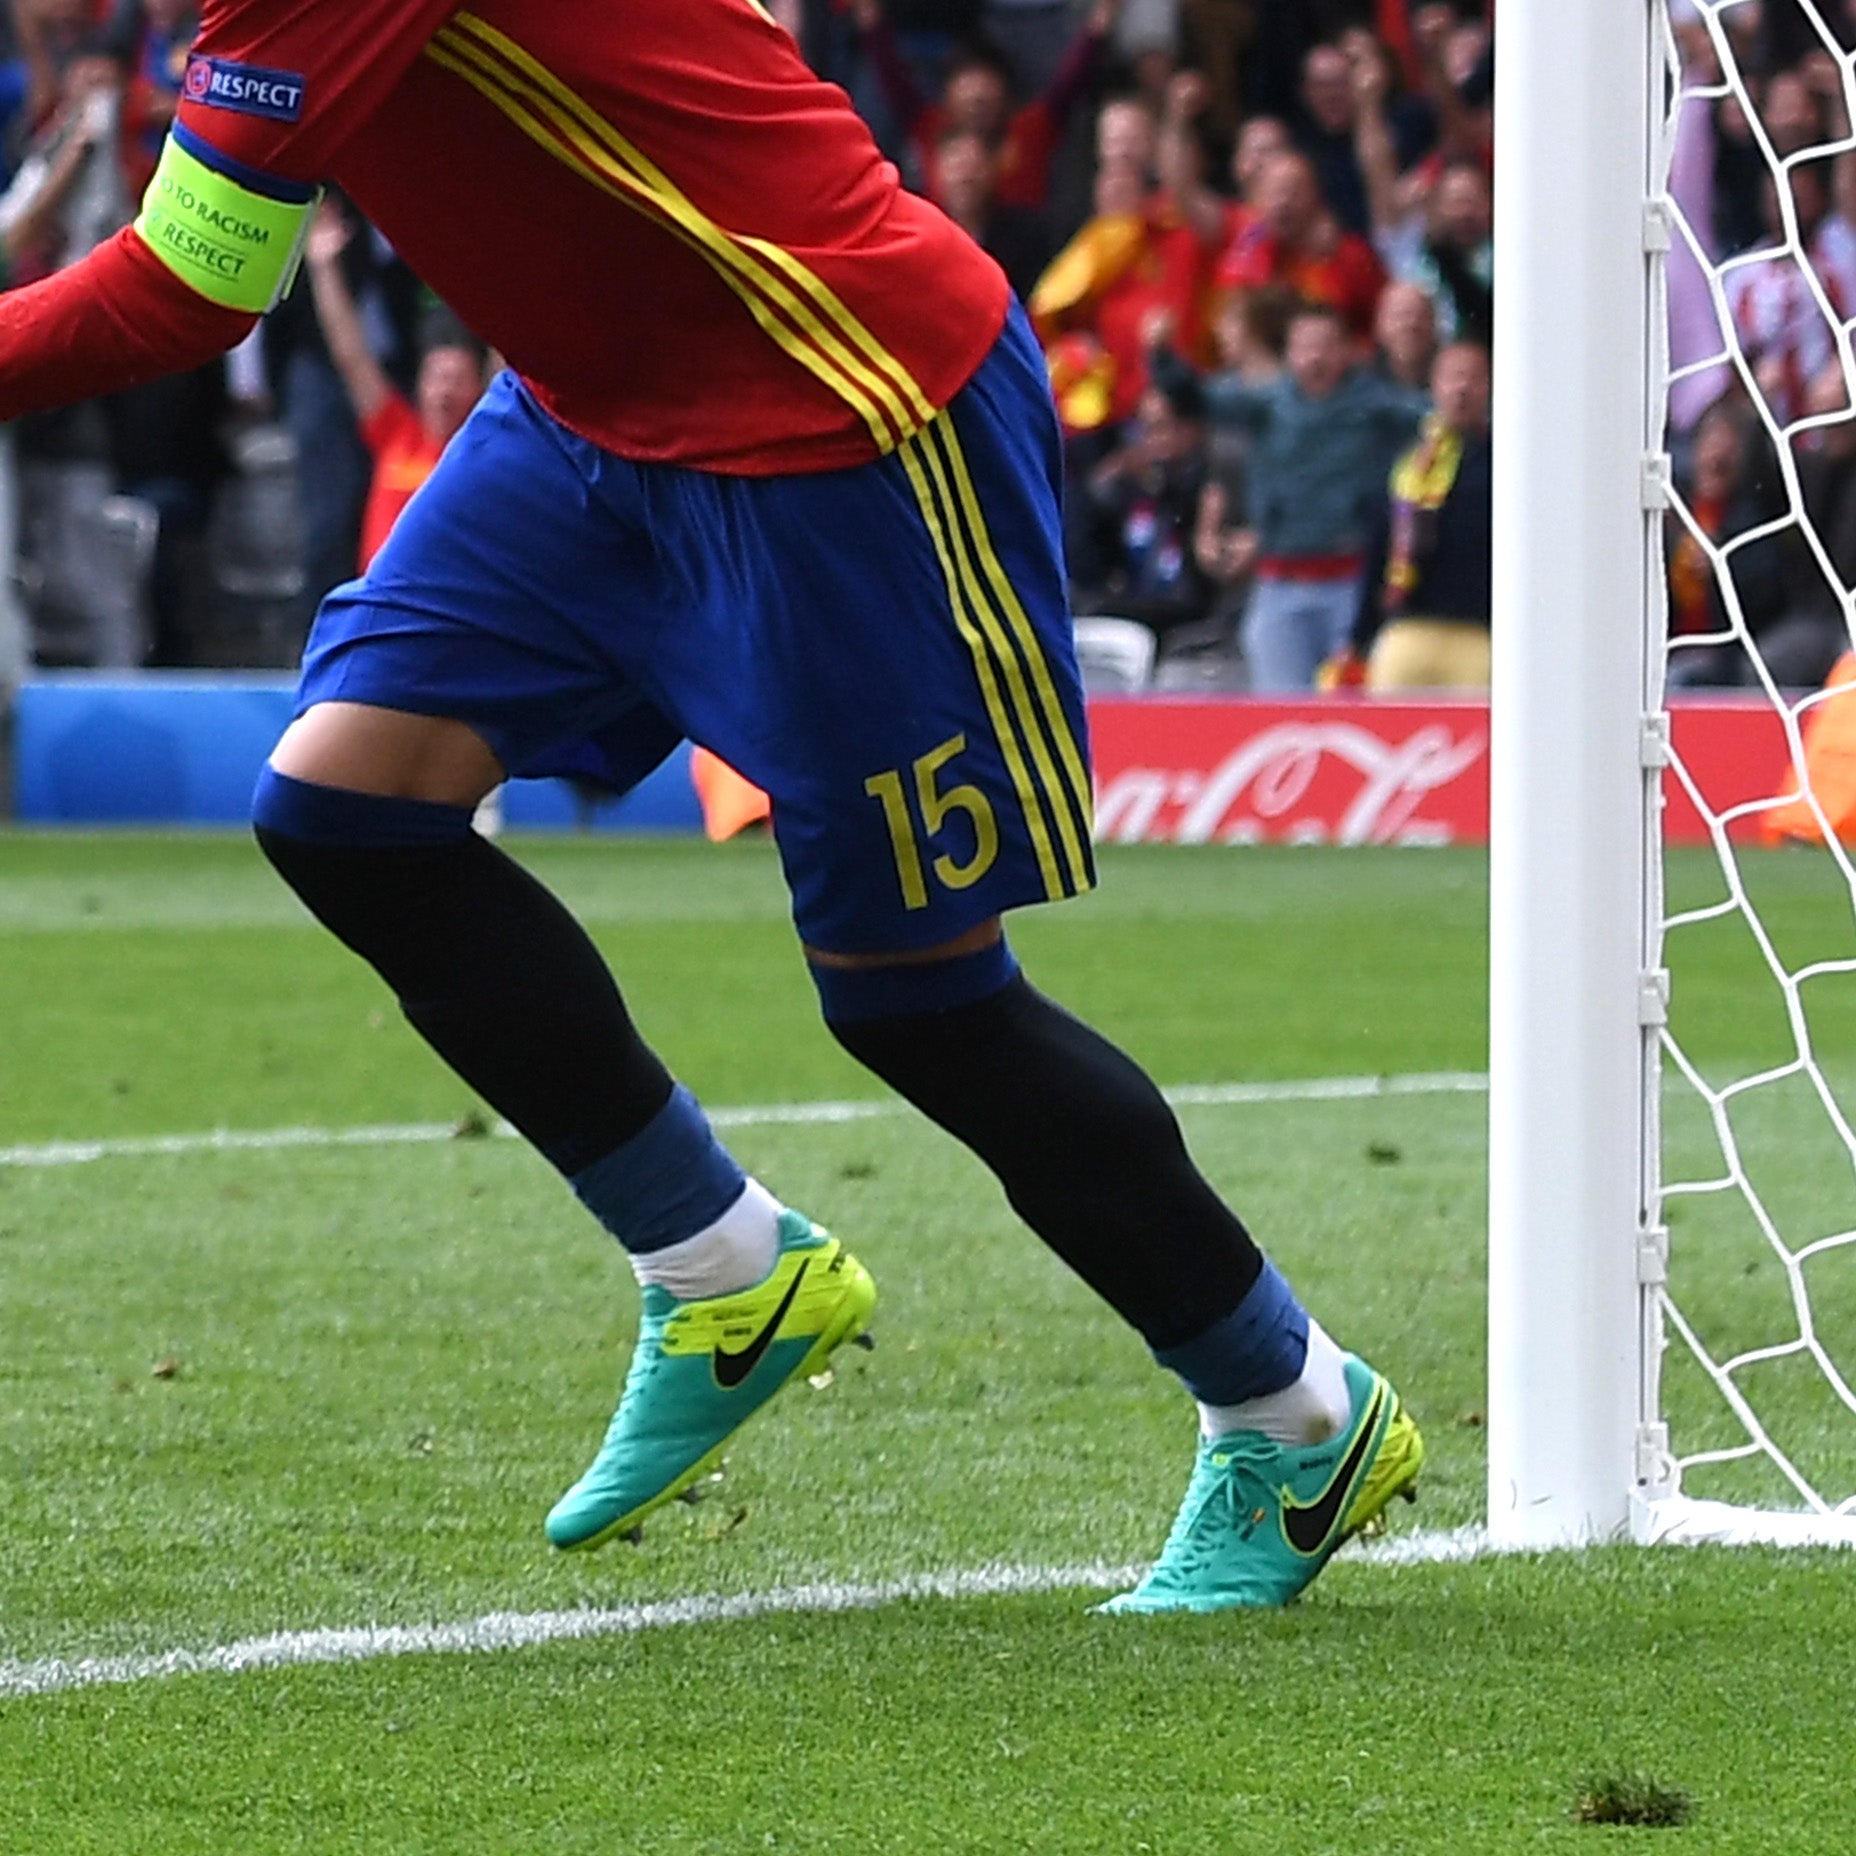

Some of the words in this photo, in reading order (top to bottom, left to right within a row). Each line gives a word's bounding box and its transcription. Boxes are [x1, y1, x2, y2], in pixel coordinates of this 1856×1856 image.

[210, 71, 301, 108] RESPECT
[175, 185, 195, 210] TO
[196, 202, 270, 245] RACISM
[163, 222, 246, 275] RESPECT
[864, 733, 1000, 911] 15
